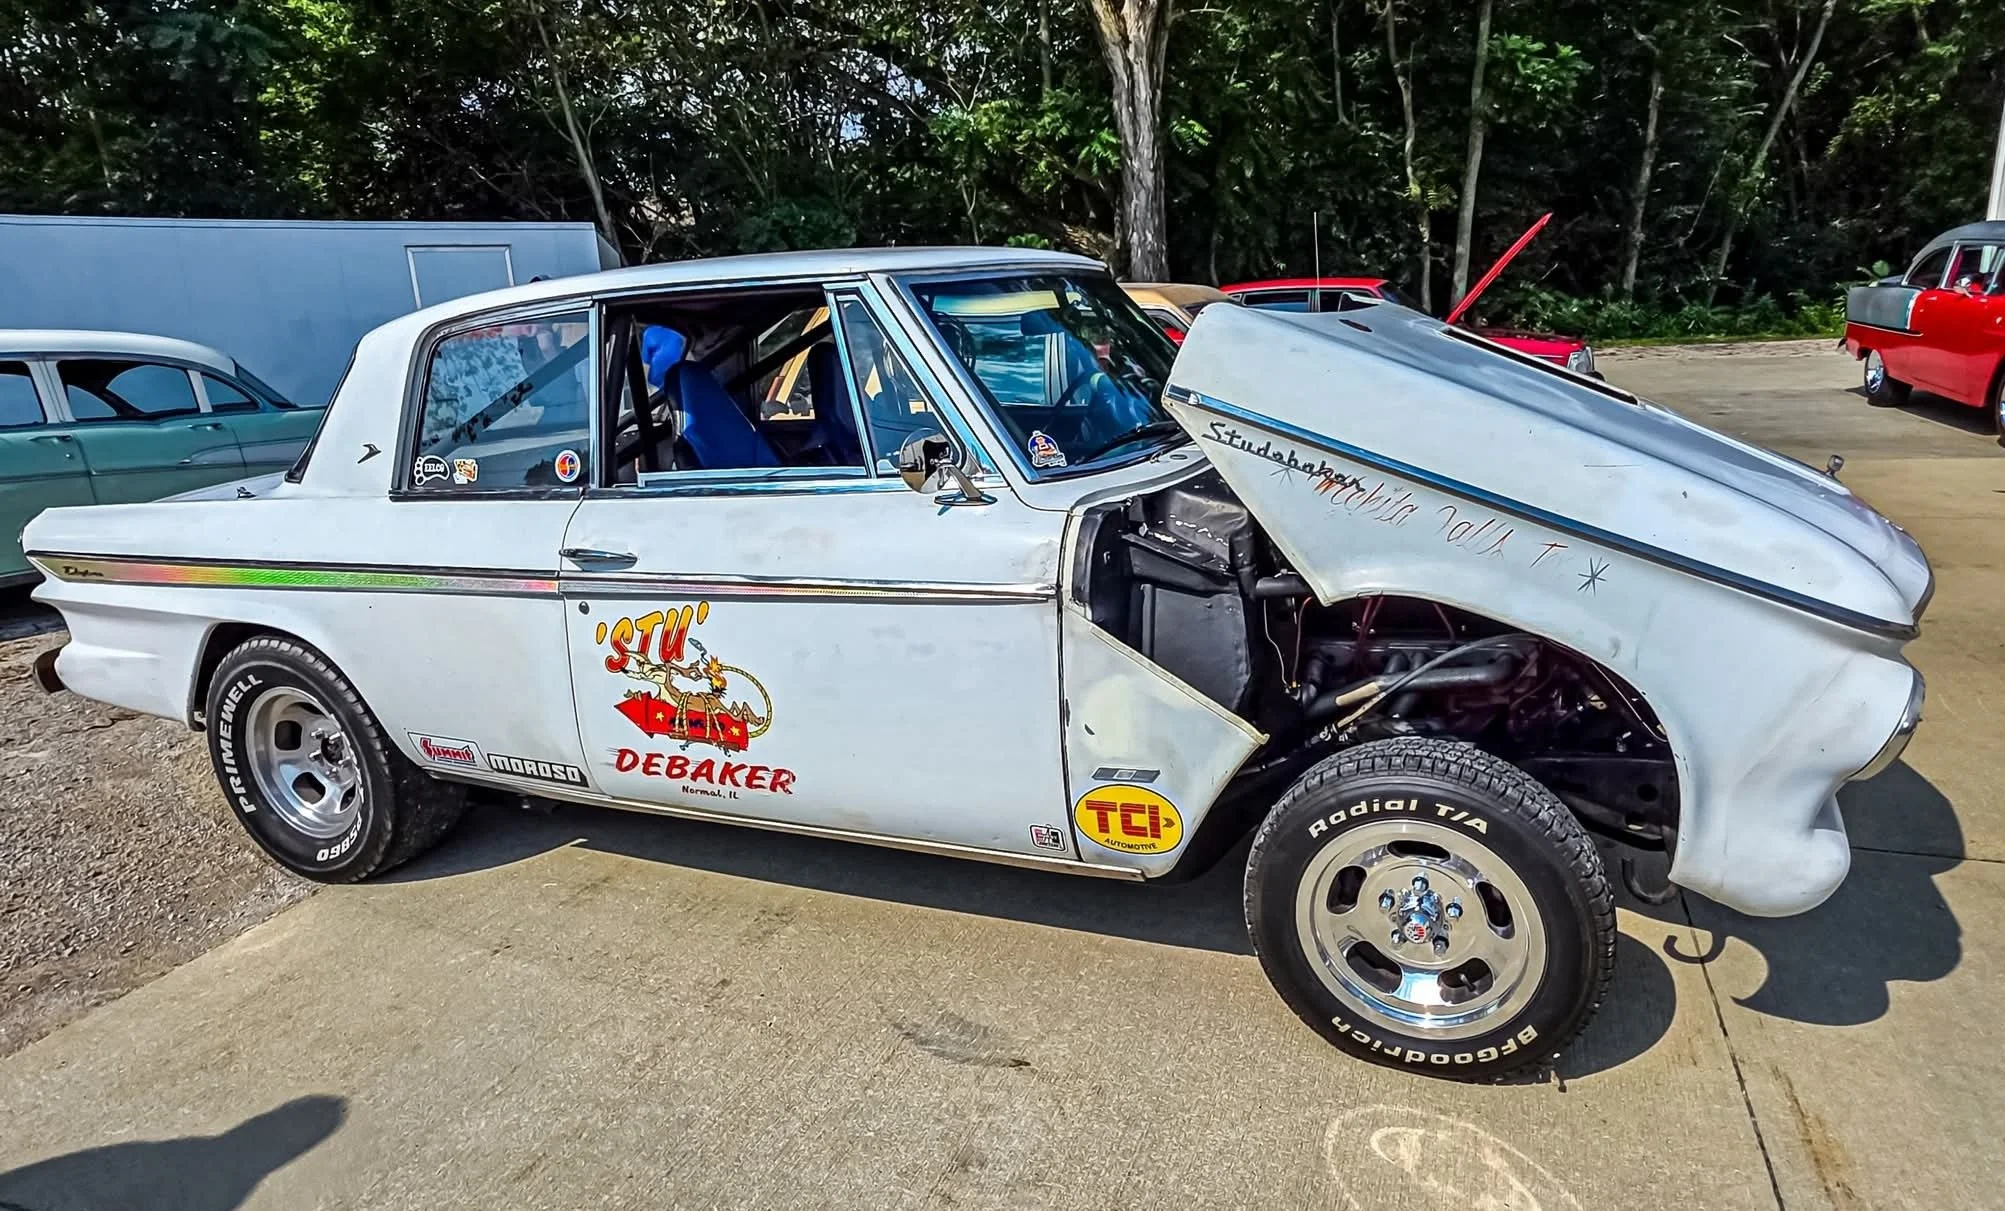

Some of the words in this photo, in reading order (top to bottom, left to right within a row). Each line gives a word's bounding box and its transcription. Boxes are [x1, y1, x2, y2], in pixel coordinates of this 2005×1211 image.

[1202, 421, 1366, 492] Studebaker
[219, 674, 264, 814] PRIMEWELL
[490, 754, 582, 783] MOROSO
[614, 747, 797, 795] DEBAKER
[1085, 799, 1162, 840] TCI
[1308, 799, 1419, 839] Radial
[1434, 802, 1490, 835] T/A
[1104, 838, 1158, 850] AUTOMOTIVE
[1330, 1014, 1539, 1066] BFGoodrich
